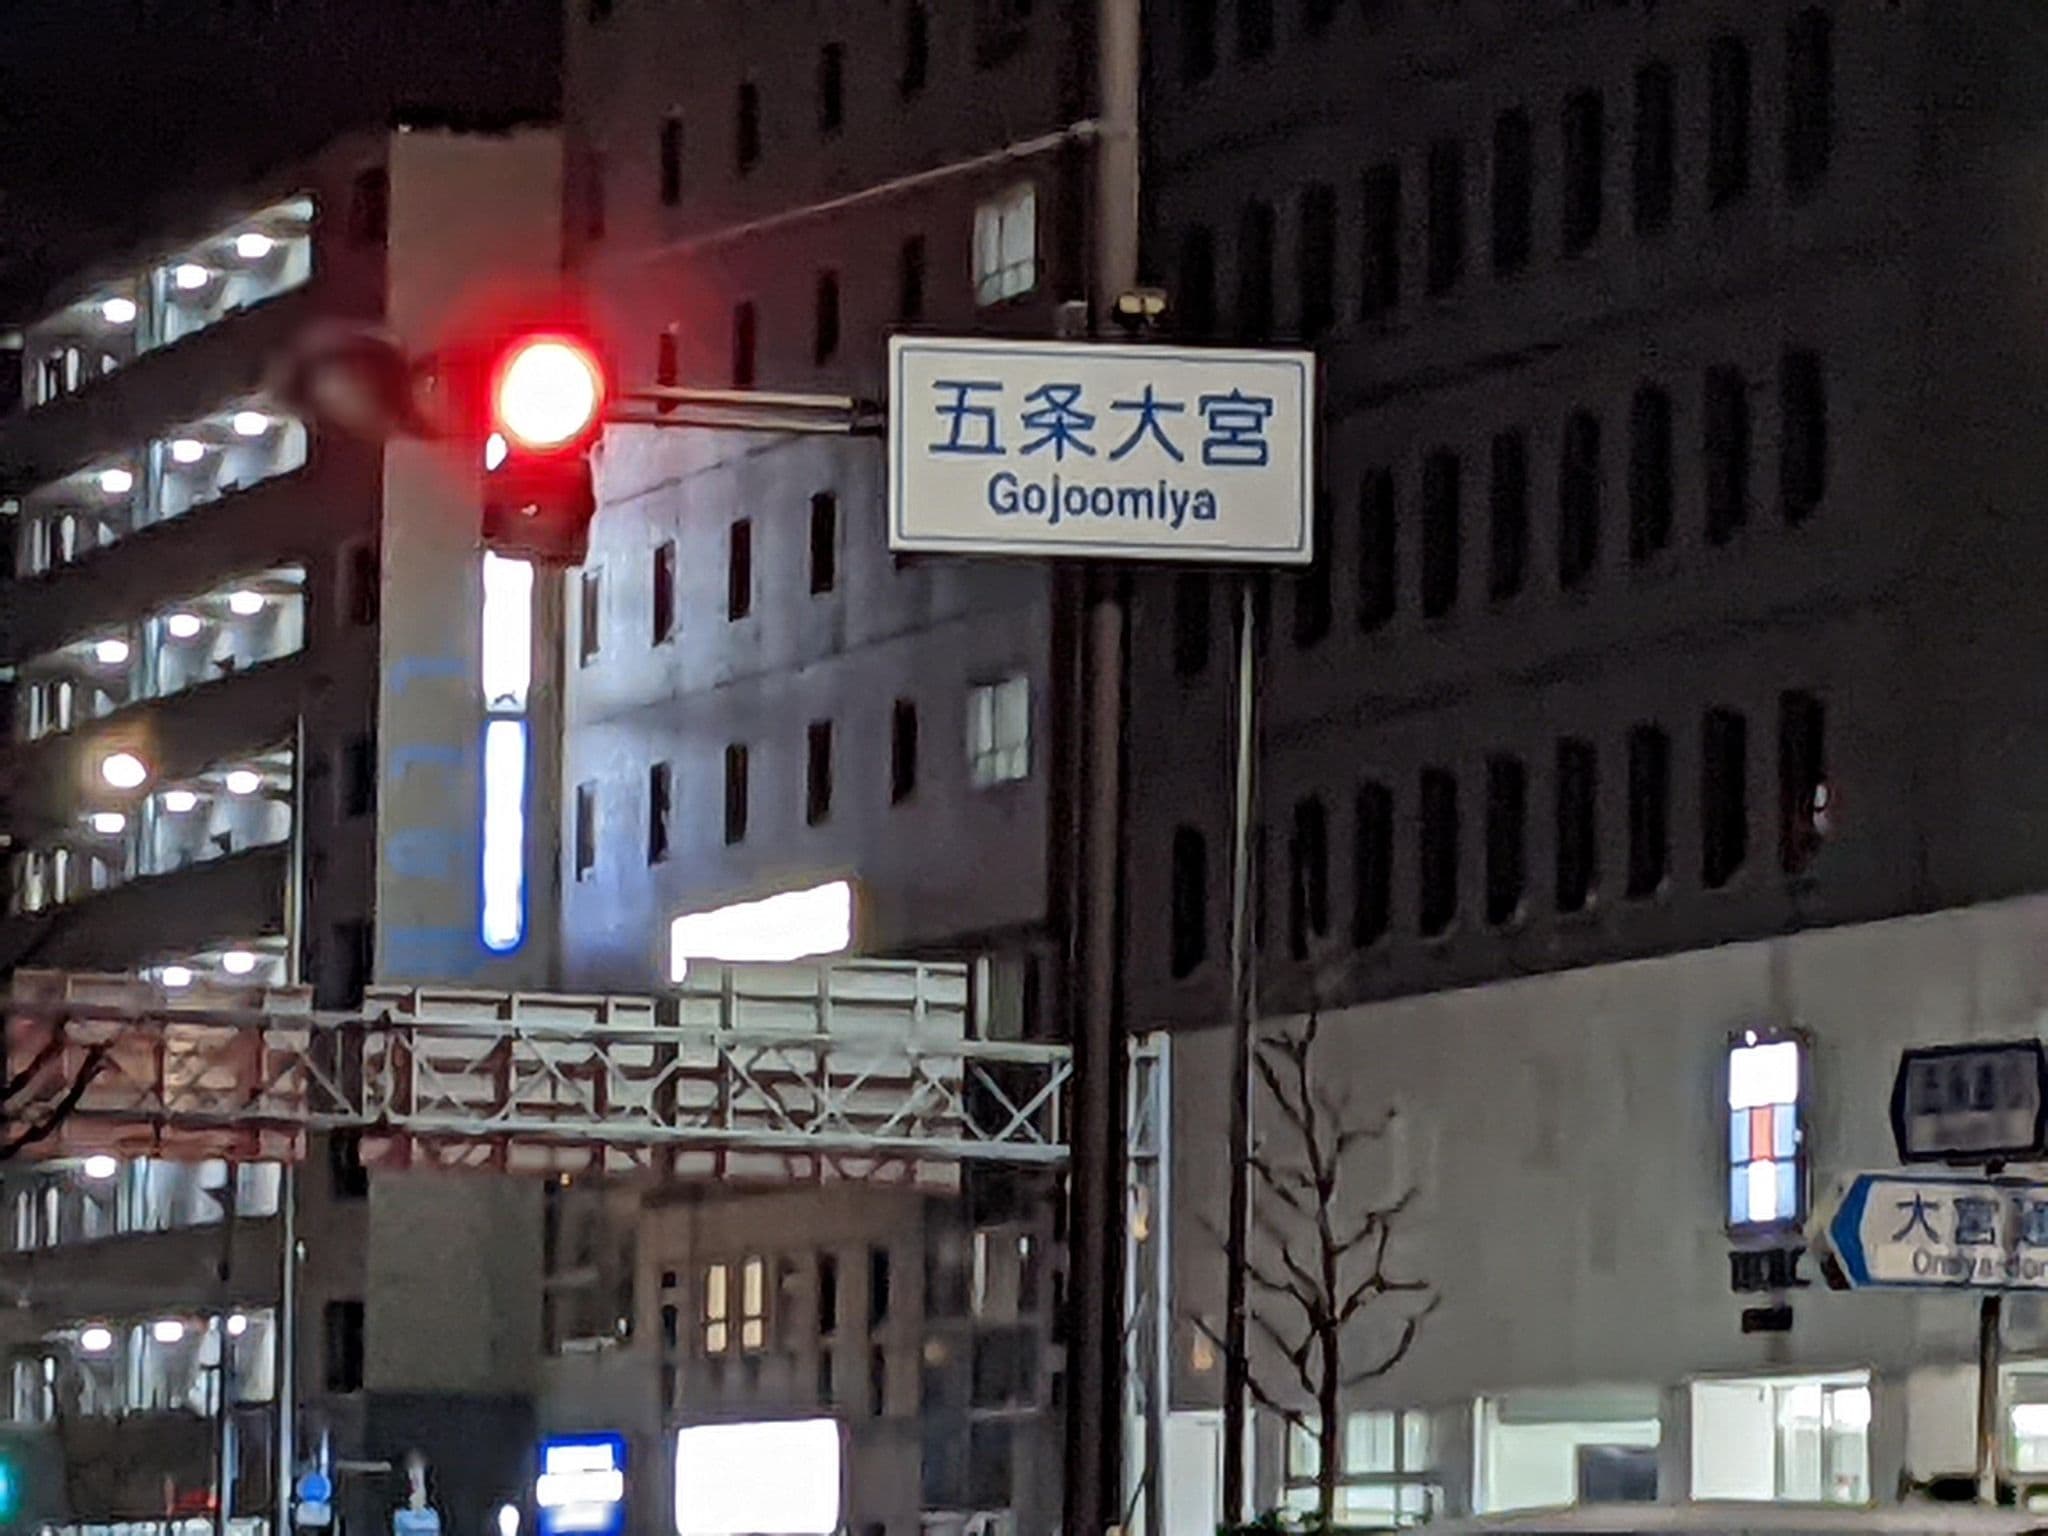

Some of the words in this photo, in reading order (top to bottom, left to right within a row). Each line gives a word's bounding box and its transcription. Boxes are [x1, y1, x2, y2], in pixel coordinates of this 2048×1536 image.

[928, 379, 1273, 466] 五条大宮
[988, 472, 1217, 529] Gojoomiya
